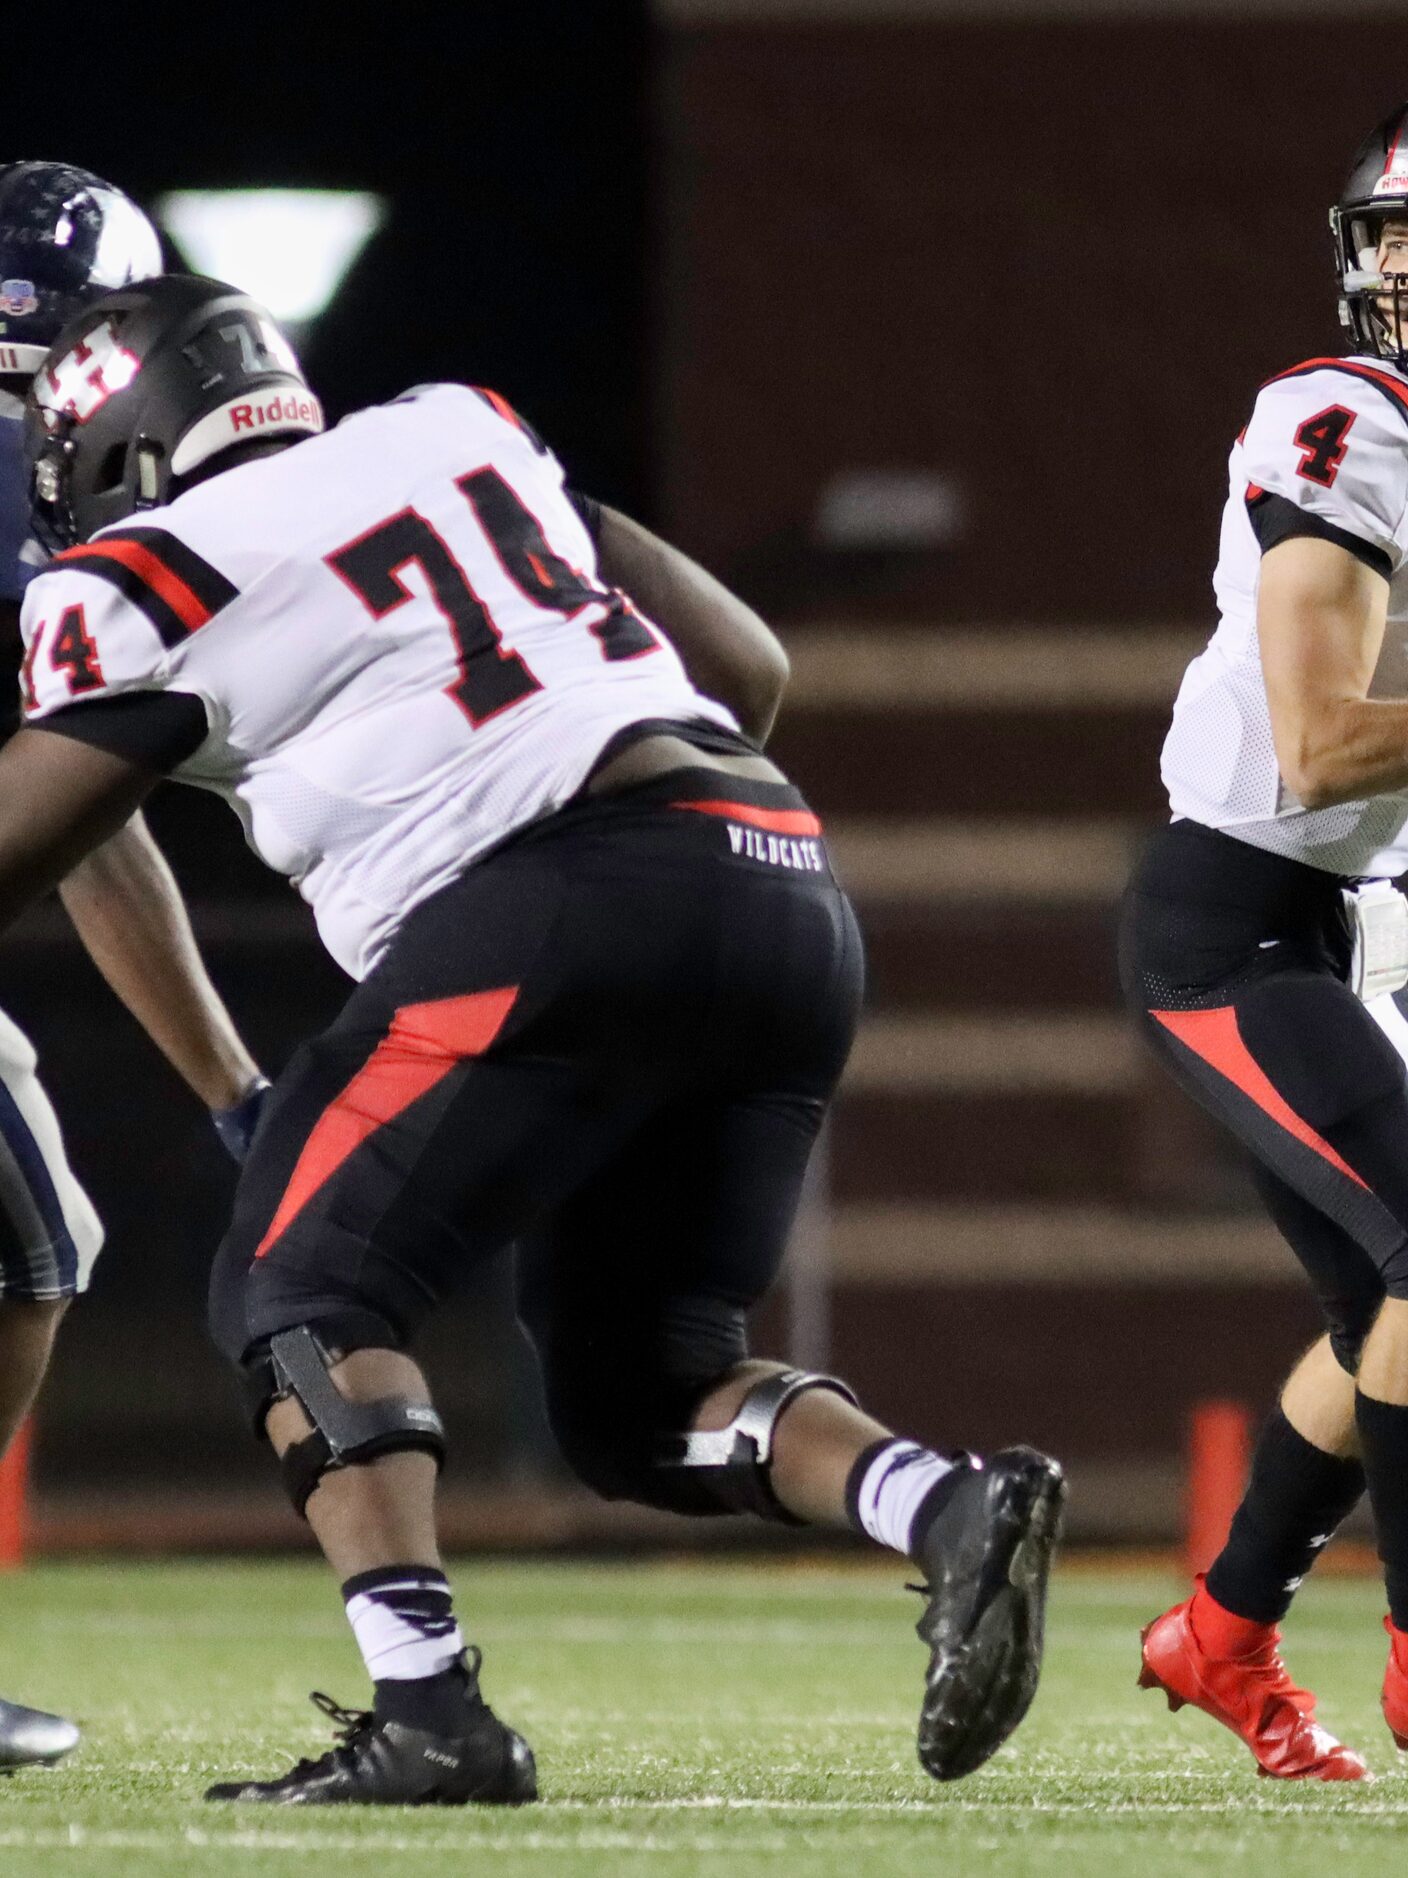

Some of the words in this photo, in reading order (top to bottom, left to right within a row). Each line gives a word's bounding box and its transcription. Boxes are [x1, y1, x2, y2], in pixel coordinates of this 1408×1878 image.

[228, 396, 321, 433] Riddell
[1294, 403, 1357, 488] 4
[322, 462, 664, 731] 74
[727, 824, 823, 872] WILDCATS
[423, 1748, 460, 1769] VAPOR
